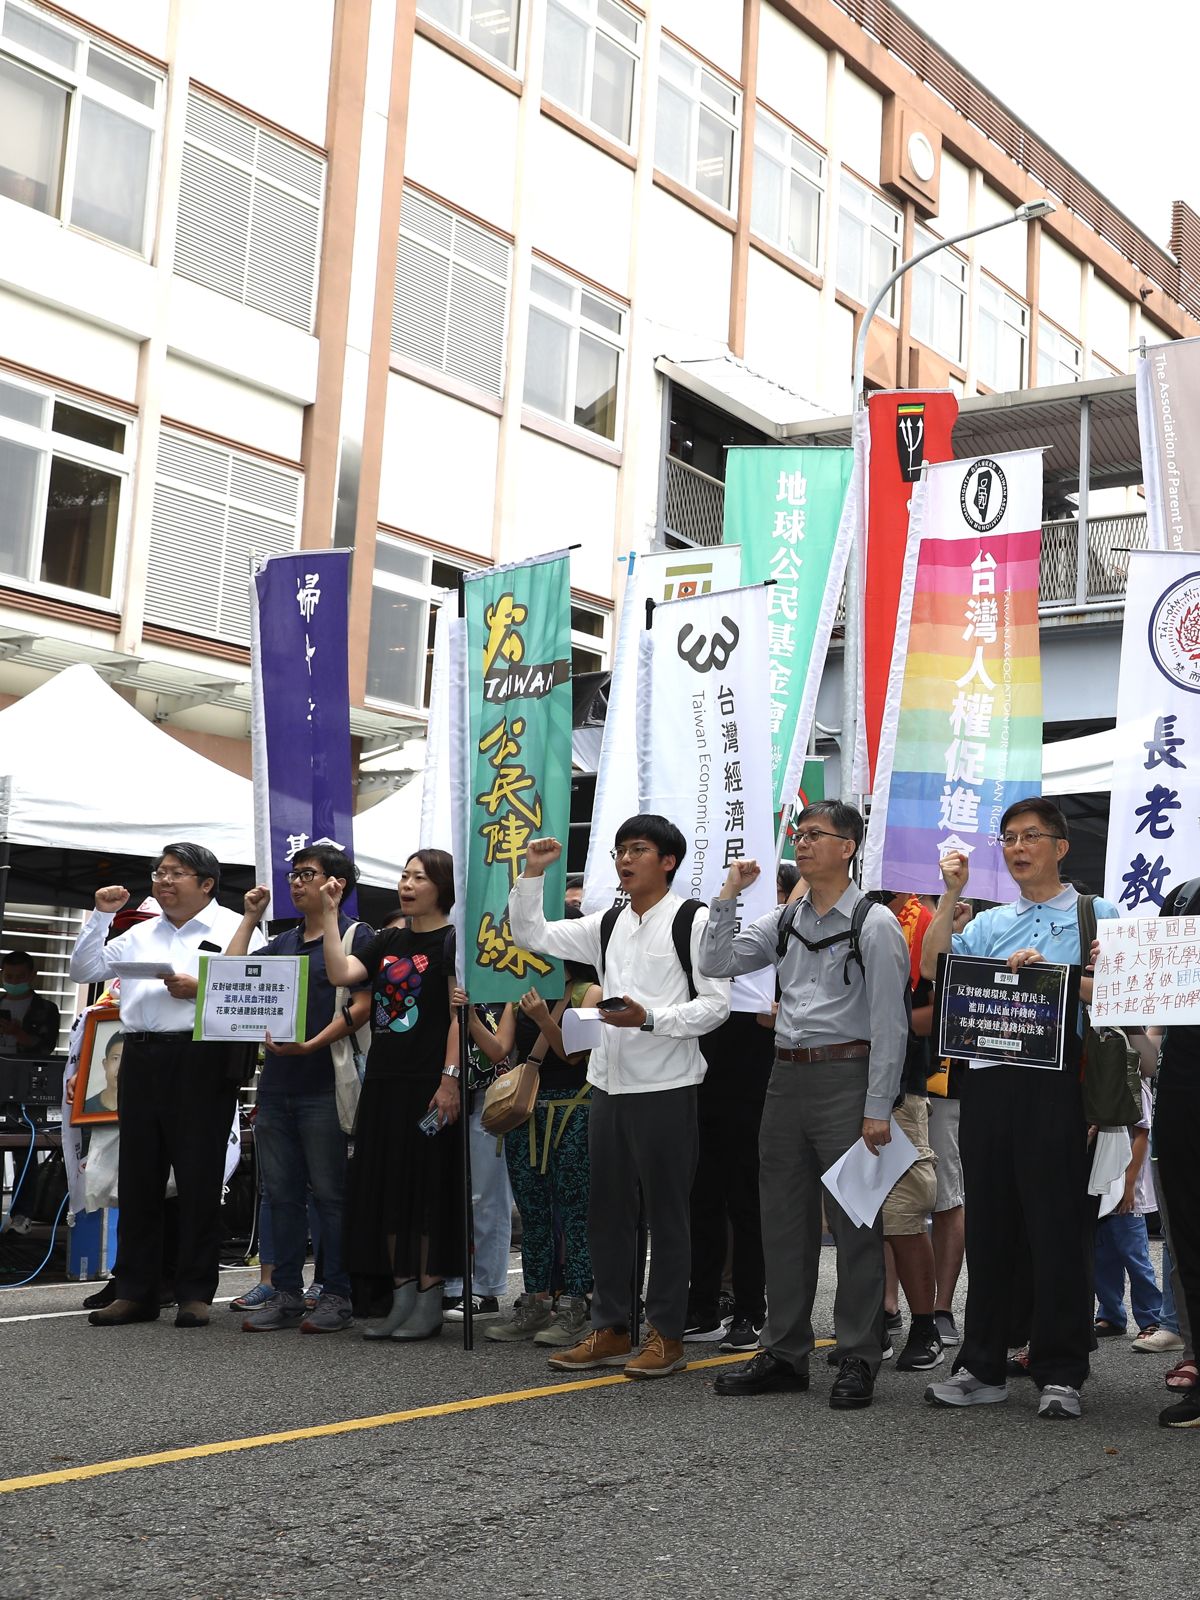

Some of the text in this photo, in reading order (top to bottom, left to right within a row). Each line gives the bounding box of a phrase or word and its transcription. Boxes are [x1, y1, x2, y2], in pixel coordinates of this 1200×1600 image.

[1155, 352, 1168, 380] The
[1159, 383, 1179, 458] Association
[1168, 459, 1180, 477] of
[1168, 477, 1181, 522] Parent
[692, 690, 706, 749] Taiwan
[695, 754, 711, 833] Economic
